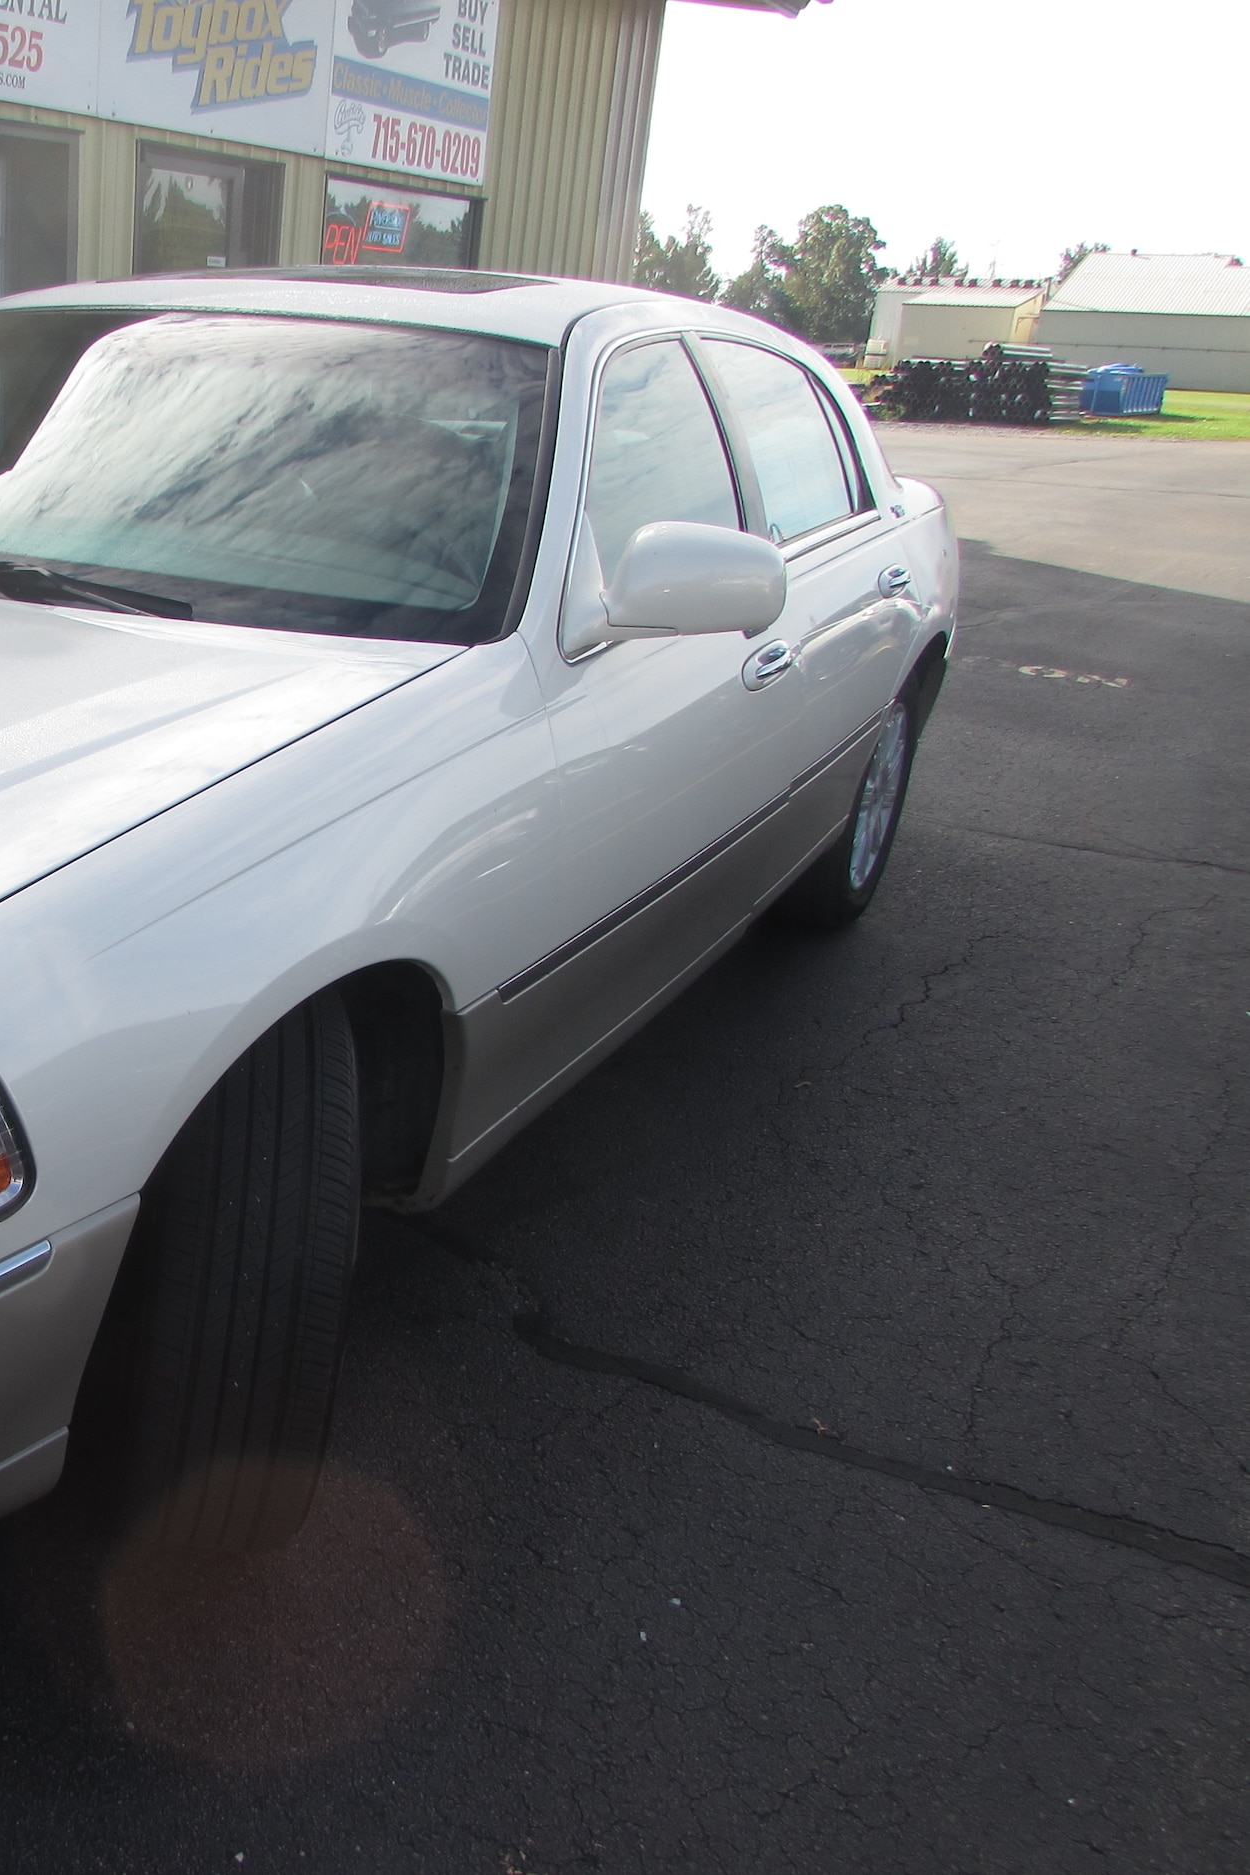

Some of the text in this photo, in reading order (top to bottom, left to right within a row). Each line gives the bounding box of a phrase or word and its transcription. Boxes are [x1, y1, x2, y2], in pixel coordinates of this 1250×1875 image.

[129, 0, 291, 66] Toybox
[457, 0, 488, 26] BUY
[451, 22, 486, 58] SELL
[198, 41, 317, 106] Rides
[333, 63, 381, 98] Classic
[388, 77, 432, 112] Muscle
[443, 52, 490, 90] TRADE
[371, 113, 481, 178] 715-670-0209
[325, 224, 362, 265] PEN
